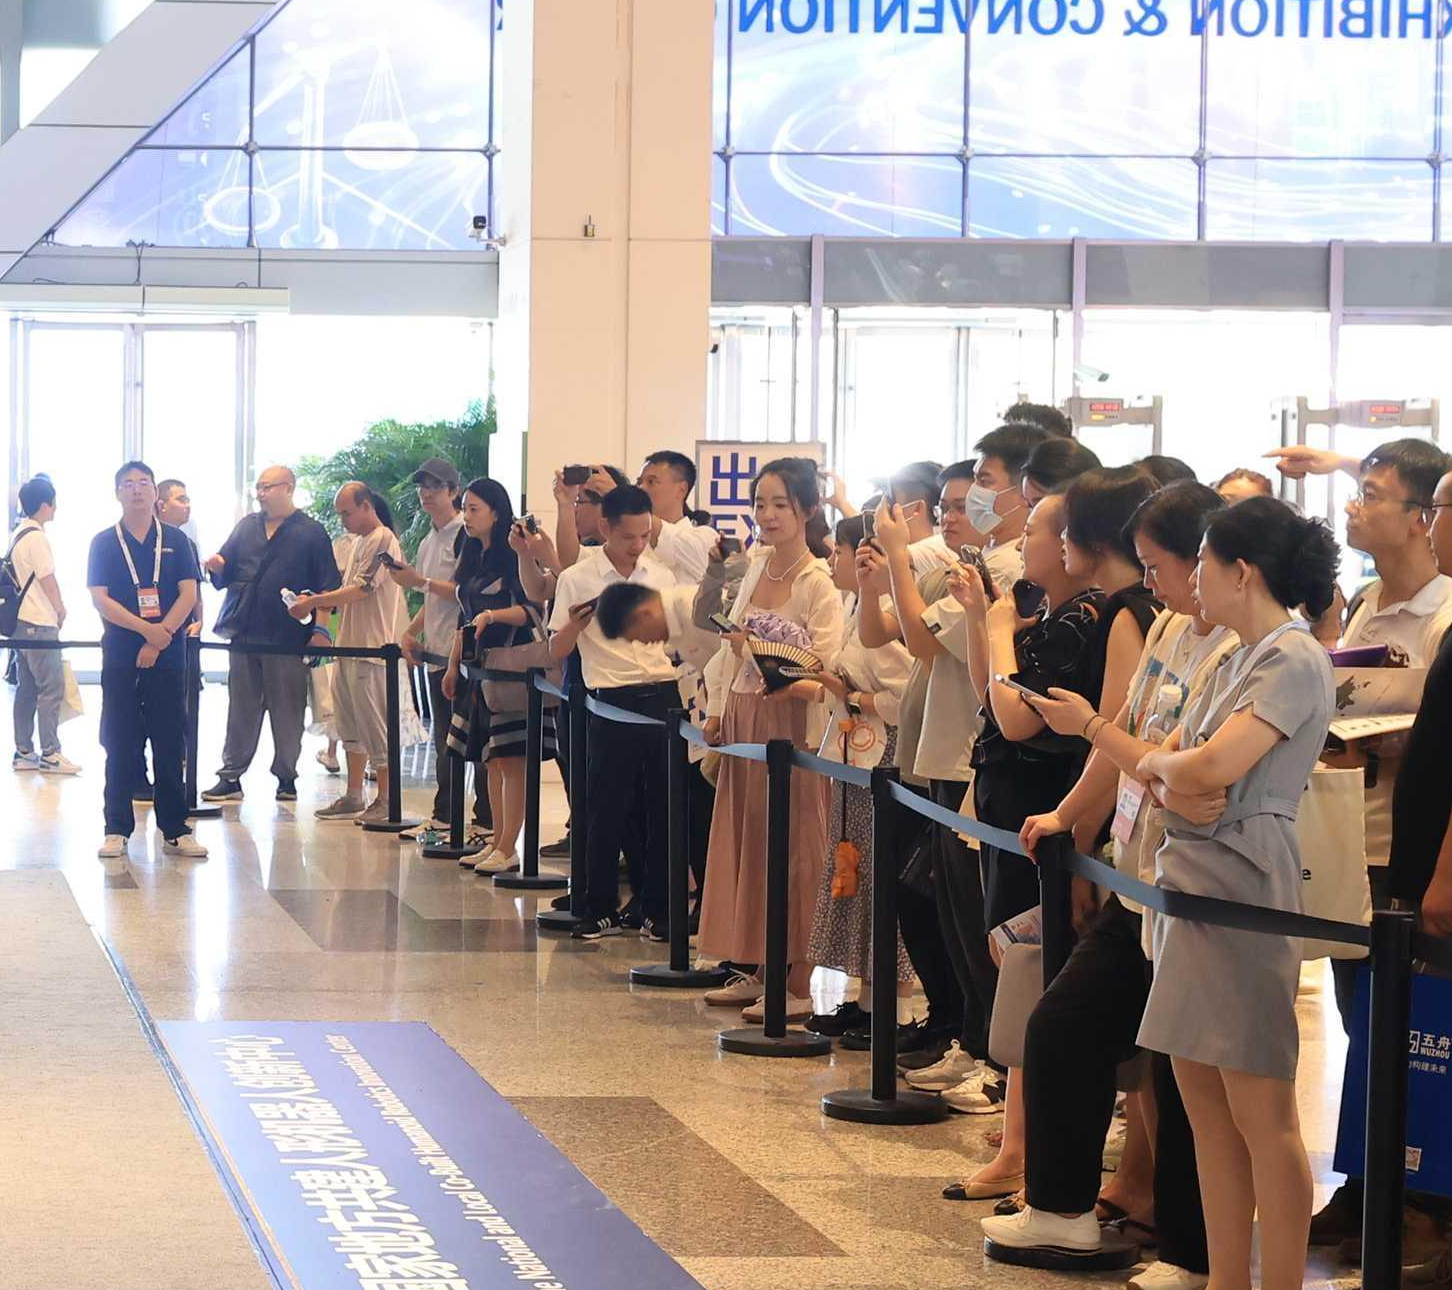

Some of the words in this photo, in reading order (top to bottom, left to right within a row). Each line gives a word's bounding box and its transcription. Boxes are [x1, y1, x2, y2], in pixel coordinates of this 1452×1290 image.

[710, 452, 757, 506] 出
[1420, 1047, 1450, 1059] WUZHOU
[1422, 1033, 1452, 1050] 五舟
[381, 1115, 446, 1155] Humanoid
[443, 1190, 498, 1215] Local
[464, 1216, 516, 1235] and
[481, 1236, 556, 1280] National
